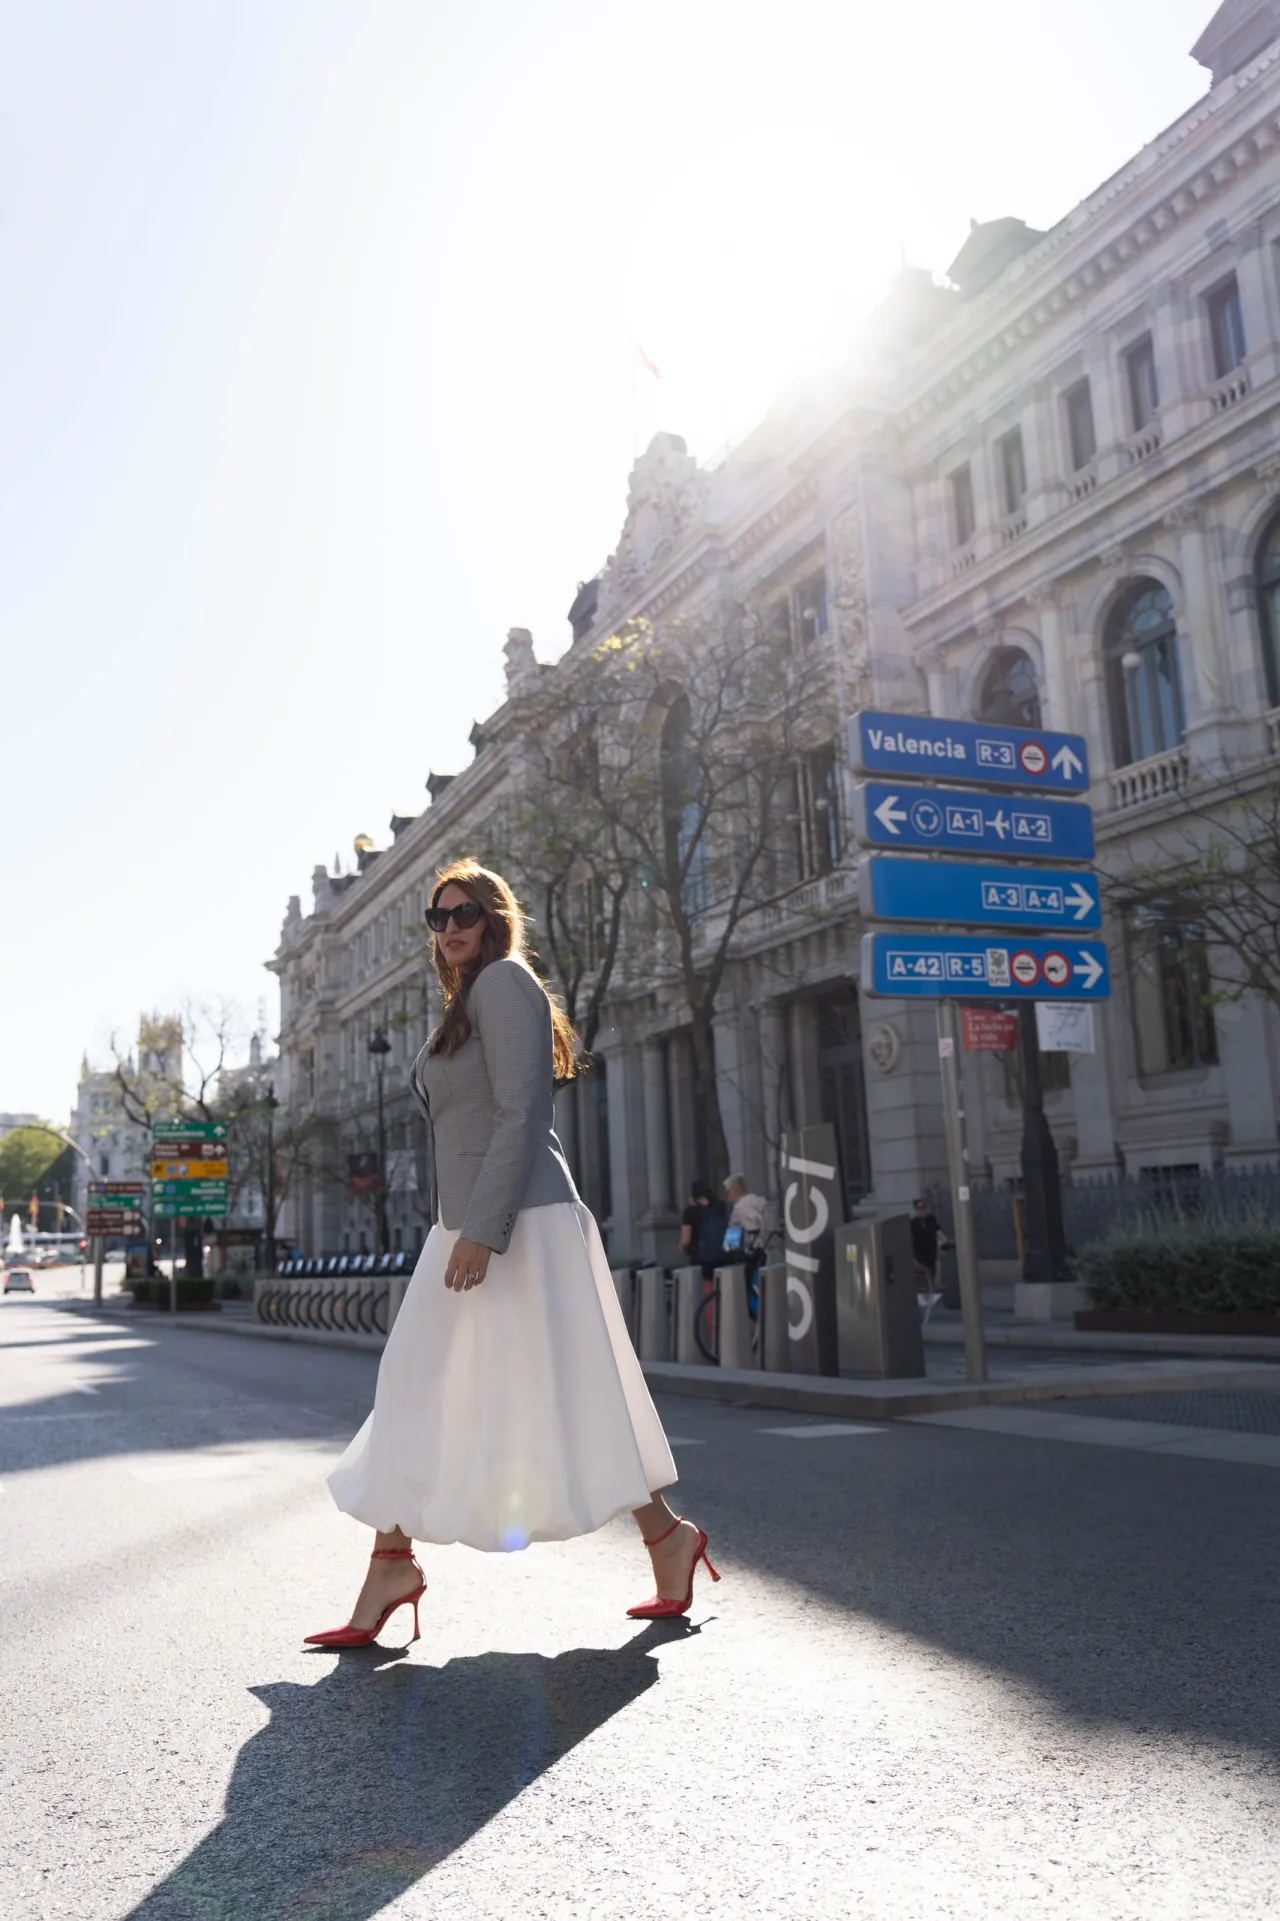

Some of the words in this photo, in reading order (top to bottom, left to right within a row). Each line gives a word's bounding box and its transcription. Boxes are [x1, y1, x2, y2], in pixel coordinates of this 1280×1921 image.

[867, 728, 967, 760] Valencia
[979, 746, 1012, 764] R-3
[951, 812, 981, 831] A-1
[1017, 817, 1048, 837] A-2
[987, 886, 1019, 906] A-3
[1028, 890, 1060, 908] A-4
[892, 956, 941, 975] A-42
[951, 959, 984, 976] R-5
